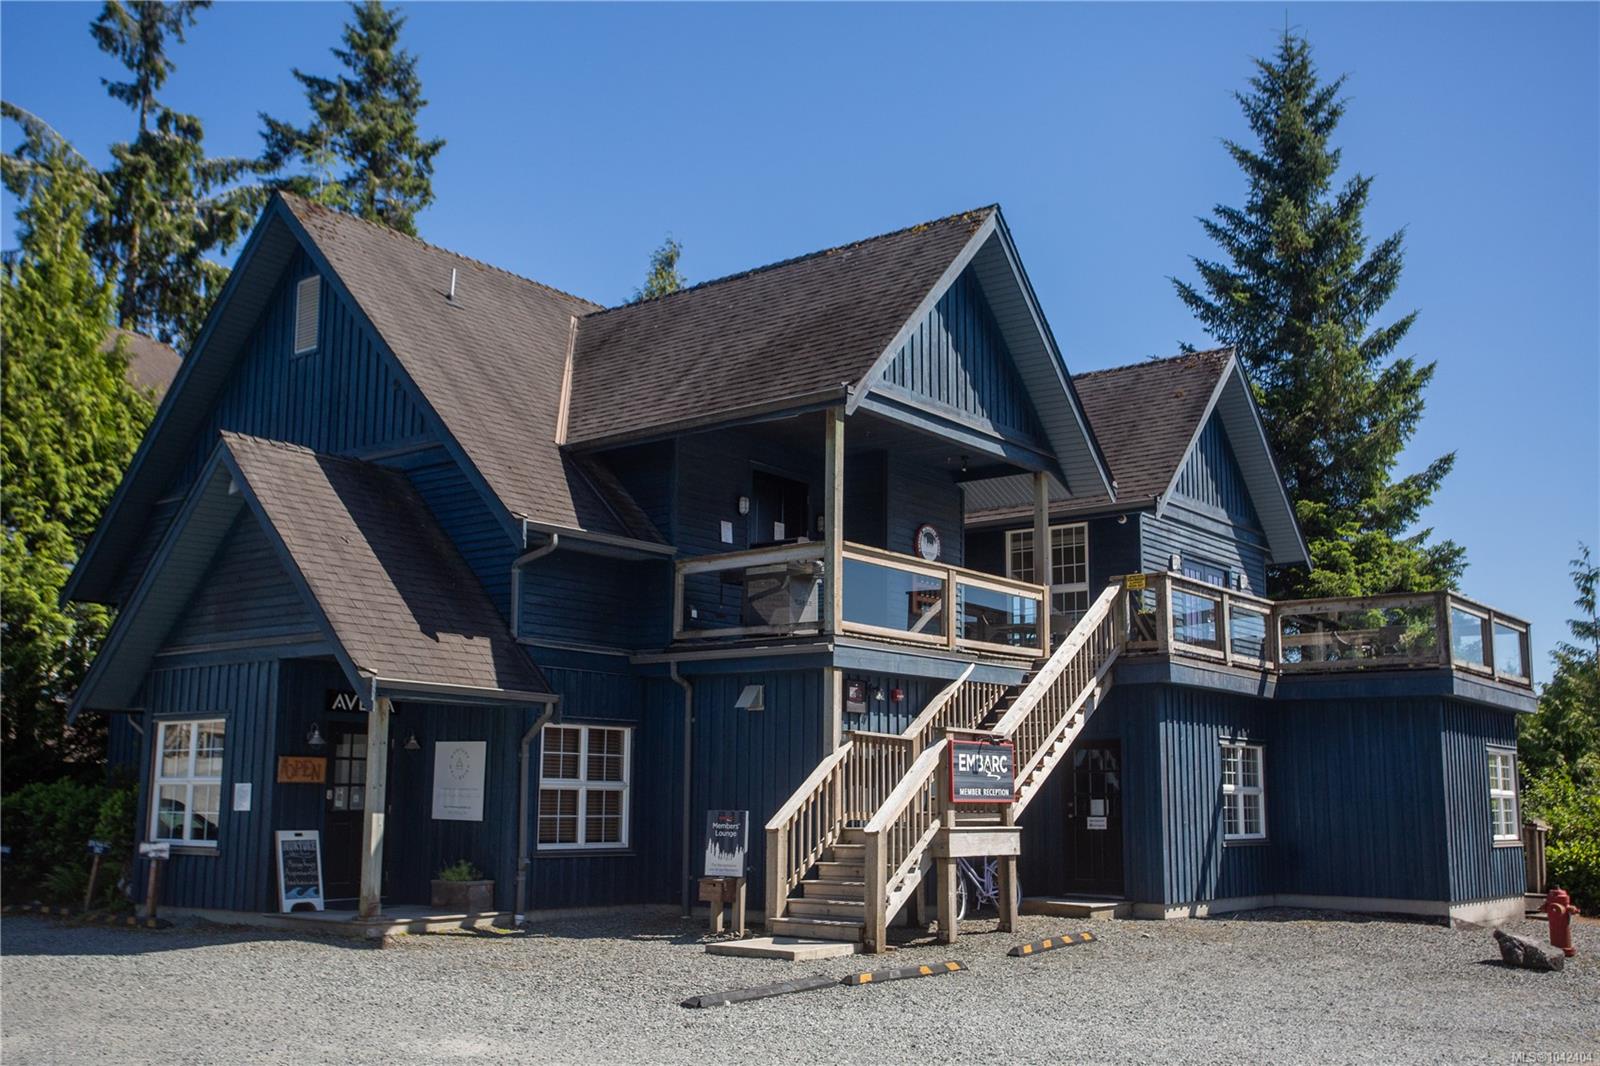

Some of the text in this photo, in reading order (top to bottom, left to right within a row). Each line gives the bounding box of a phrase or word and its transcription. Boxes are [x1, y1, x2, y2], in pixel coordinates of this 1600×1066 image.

[959, 753, 1008, 774] EMBARC
[960, 787, 1009, 796] MEMBER RECEPTION
[715, 830, 737, 838] Lounge
